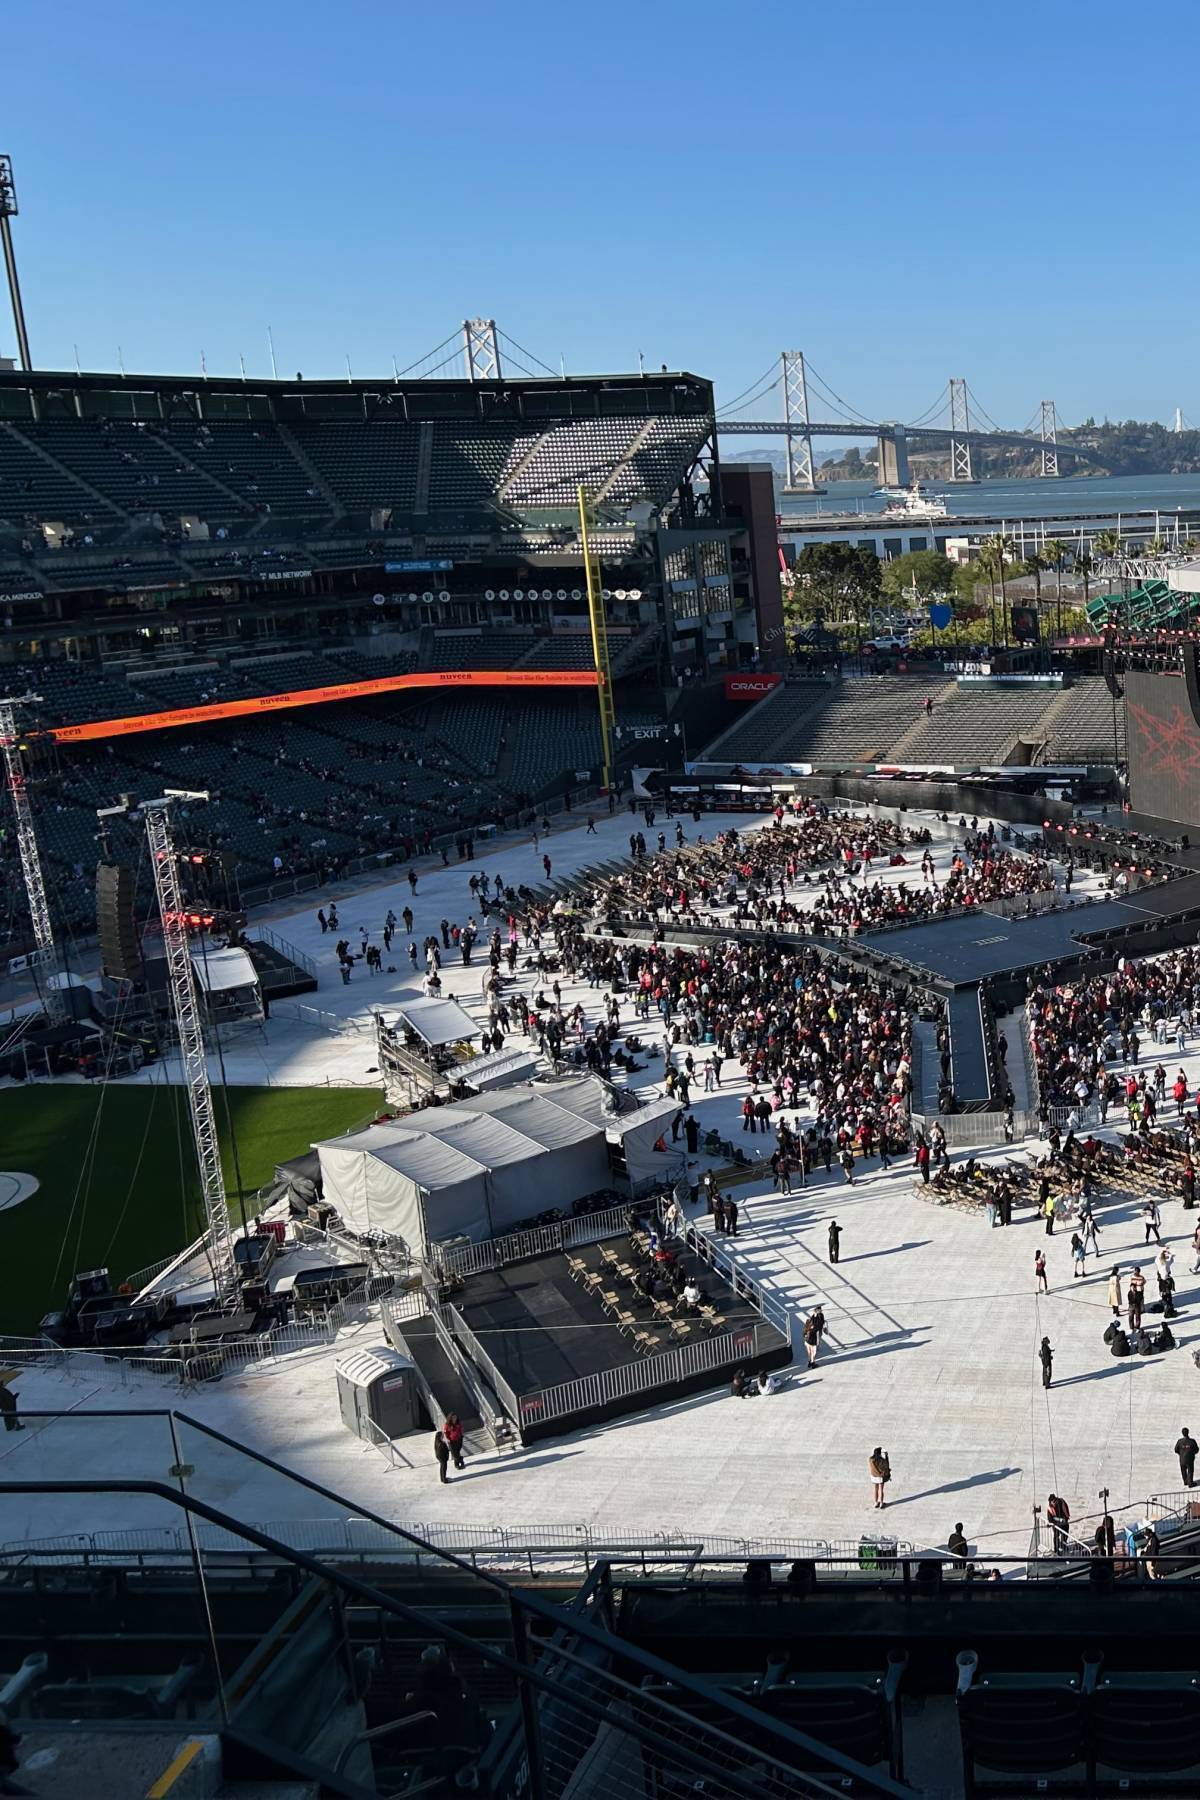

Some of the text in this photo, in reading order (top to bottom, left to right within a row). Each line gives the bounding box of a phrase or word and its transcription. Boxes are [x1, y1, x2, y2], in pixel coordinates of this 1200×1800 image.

[283, 571, 312, 579] NETWORK
[730, 682, 776, 691] ORACLE
[57, 728, 81, 737] veen
[634, 730, 661, 739] EXIT
